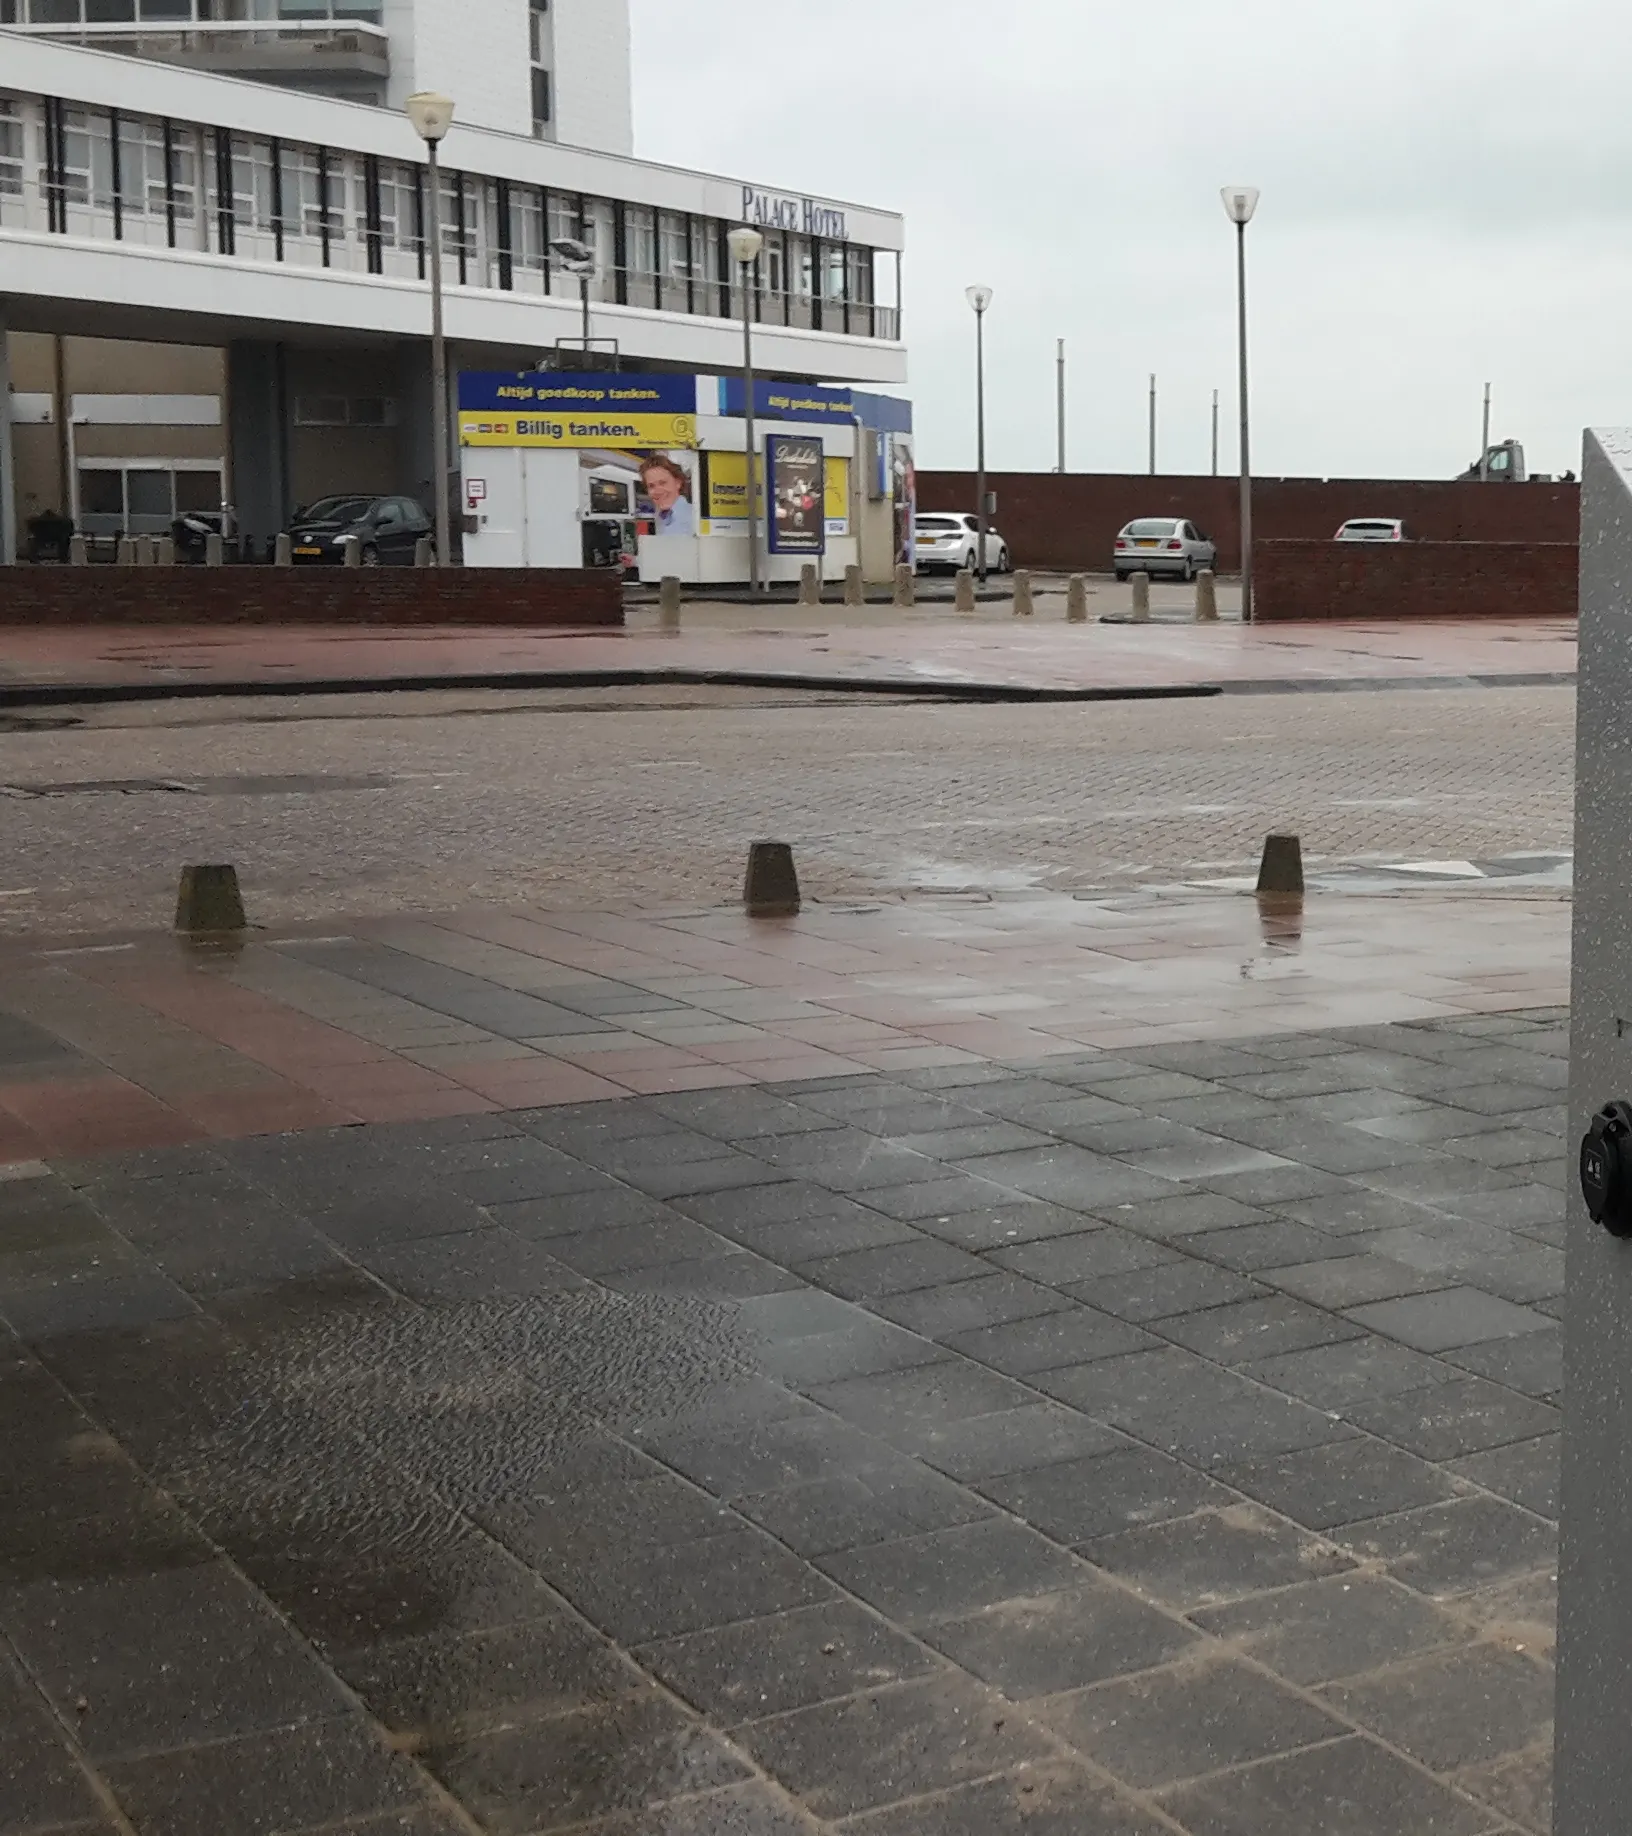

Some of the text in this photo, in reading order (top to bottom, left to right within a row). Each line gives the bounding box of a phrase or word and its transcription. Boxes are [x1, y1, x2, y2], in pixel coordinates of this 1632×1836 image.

[742, 185, 850, 240] PALACE HOTEL
[497, 386, 660, 401] Altijd goedkoop tanken.
[516, 420, 563, 439] Billig
[569, 421, 640, 437] tanken.
